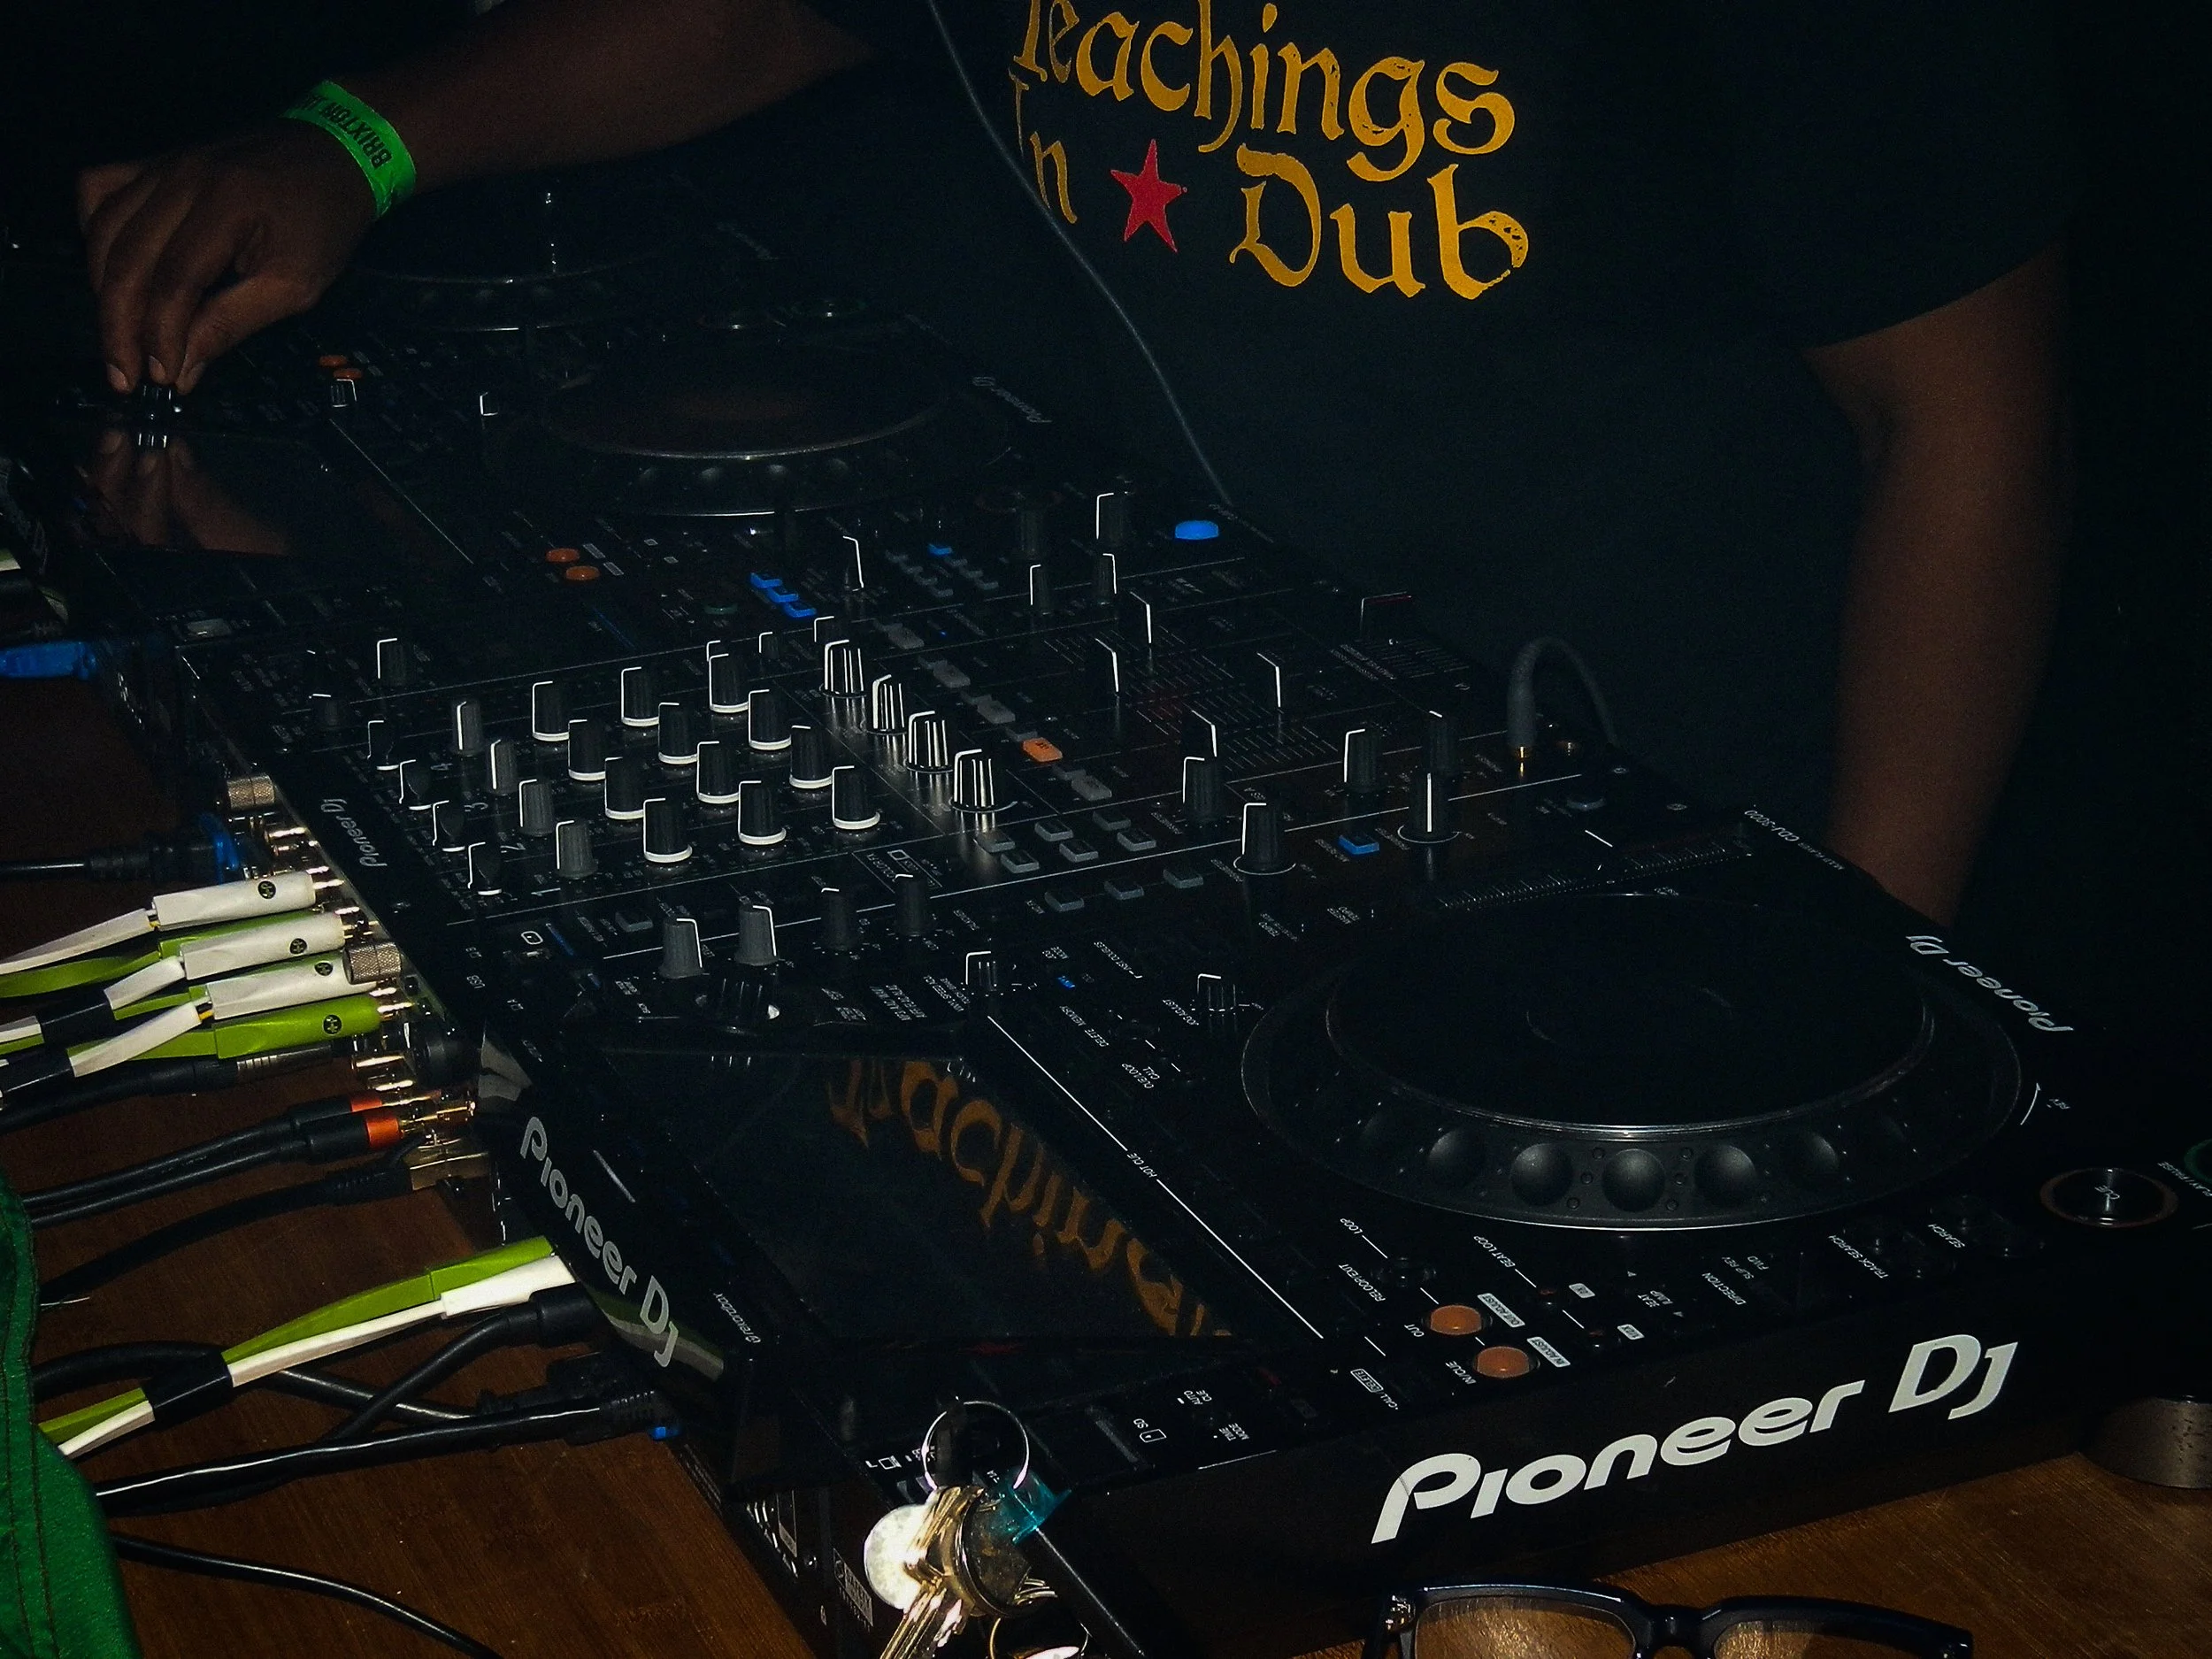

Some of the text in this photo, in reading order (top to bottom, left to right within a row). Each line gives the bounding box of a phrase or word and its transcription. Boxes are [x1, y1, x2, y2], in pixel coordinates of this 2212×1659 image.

[1229, 142, 1529, 300] Dub
[320, 798, 388, 867] Pioneer DJ
[1906, 934, 2075, 1033] Pioneer DJ
[1126, 1152, 1158, 1178] HOT CUE
[2094, 1185, 2121, 1200] CUE
[1340, 1217, 1363, 1234] LOOP
[1927, 1223, 1967, 1248] SEARCH
[519, 1116, 680, 1368] Pioneer DJ
[1473, 1235, 1516, 1268] BEAT LOOP
[1701, 1271, 1747, 1306] DIRECTION
[1403, 1324, 1425, 1338] OUT
[1184, 1390, 1204, 1405] AUTO
[1195, 1388, 1213, 1402] CUE
[1133, 1417, 1149, 1430] SD
[1371, 1333, 2019, 1545] Pioneer DJ
